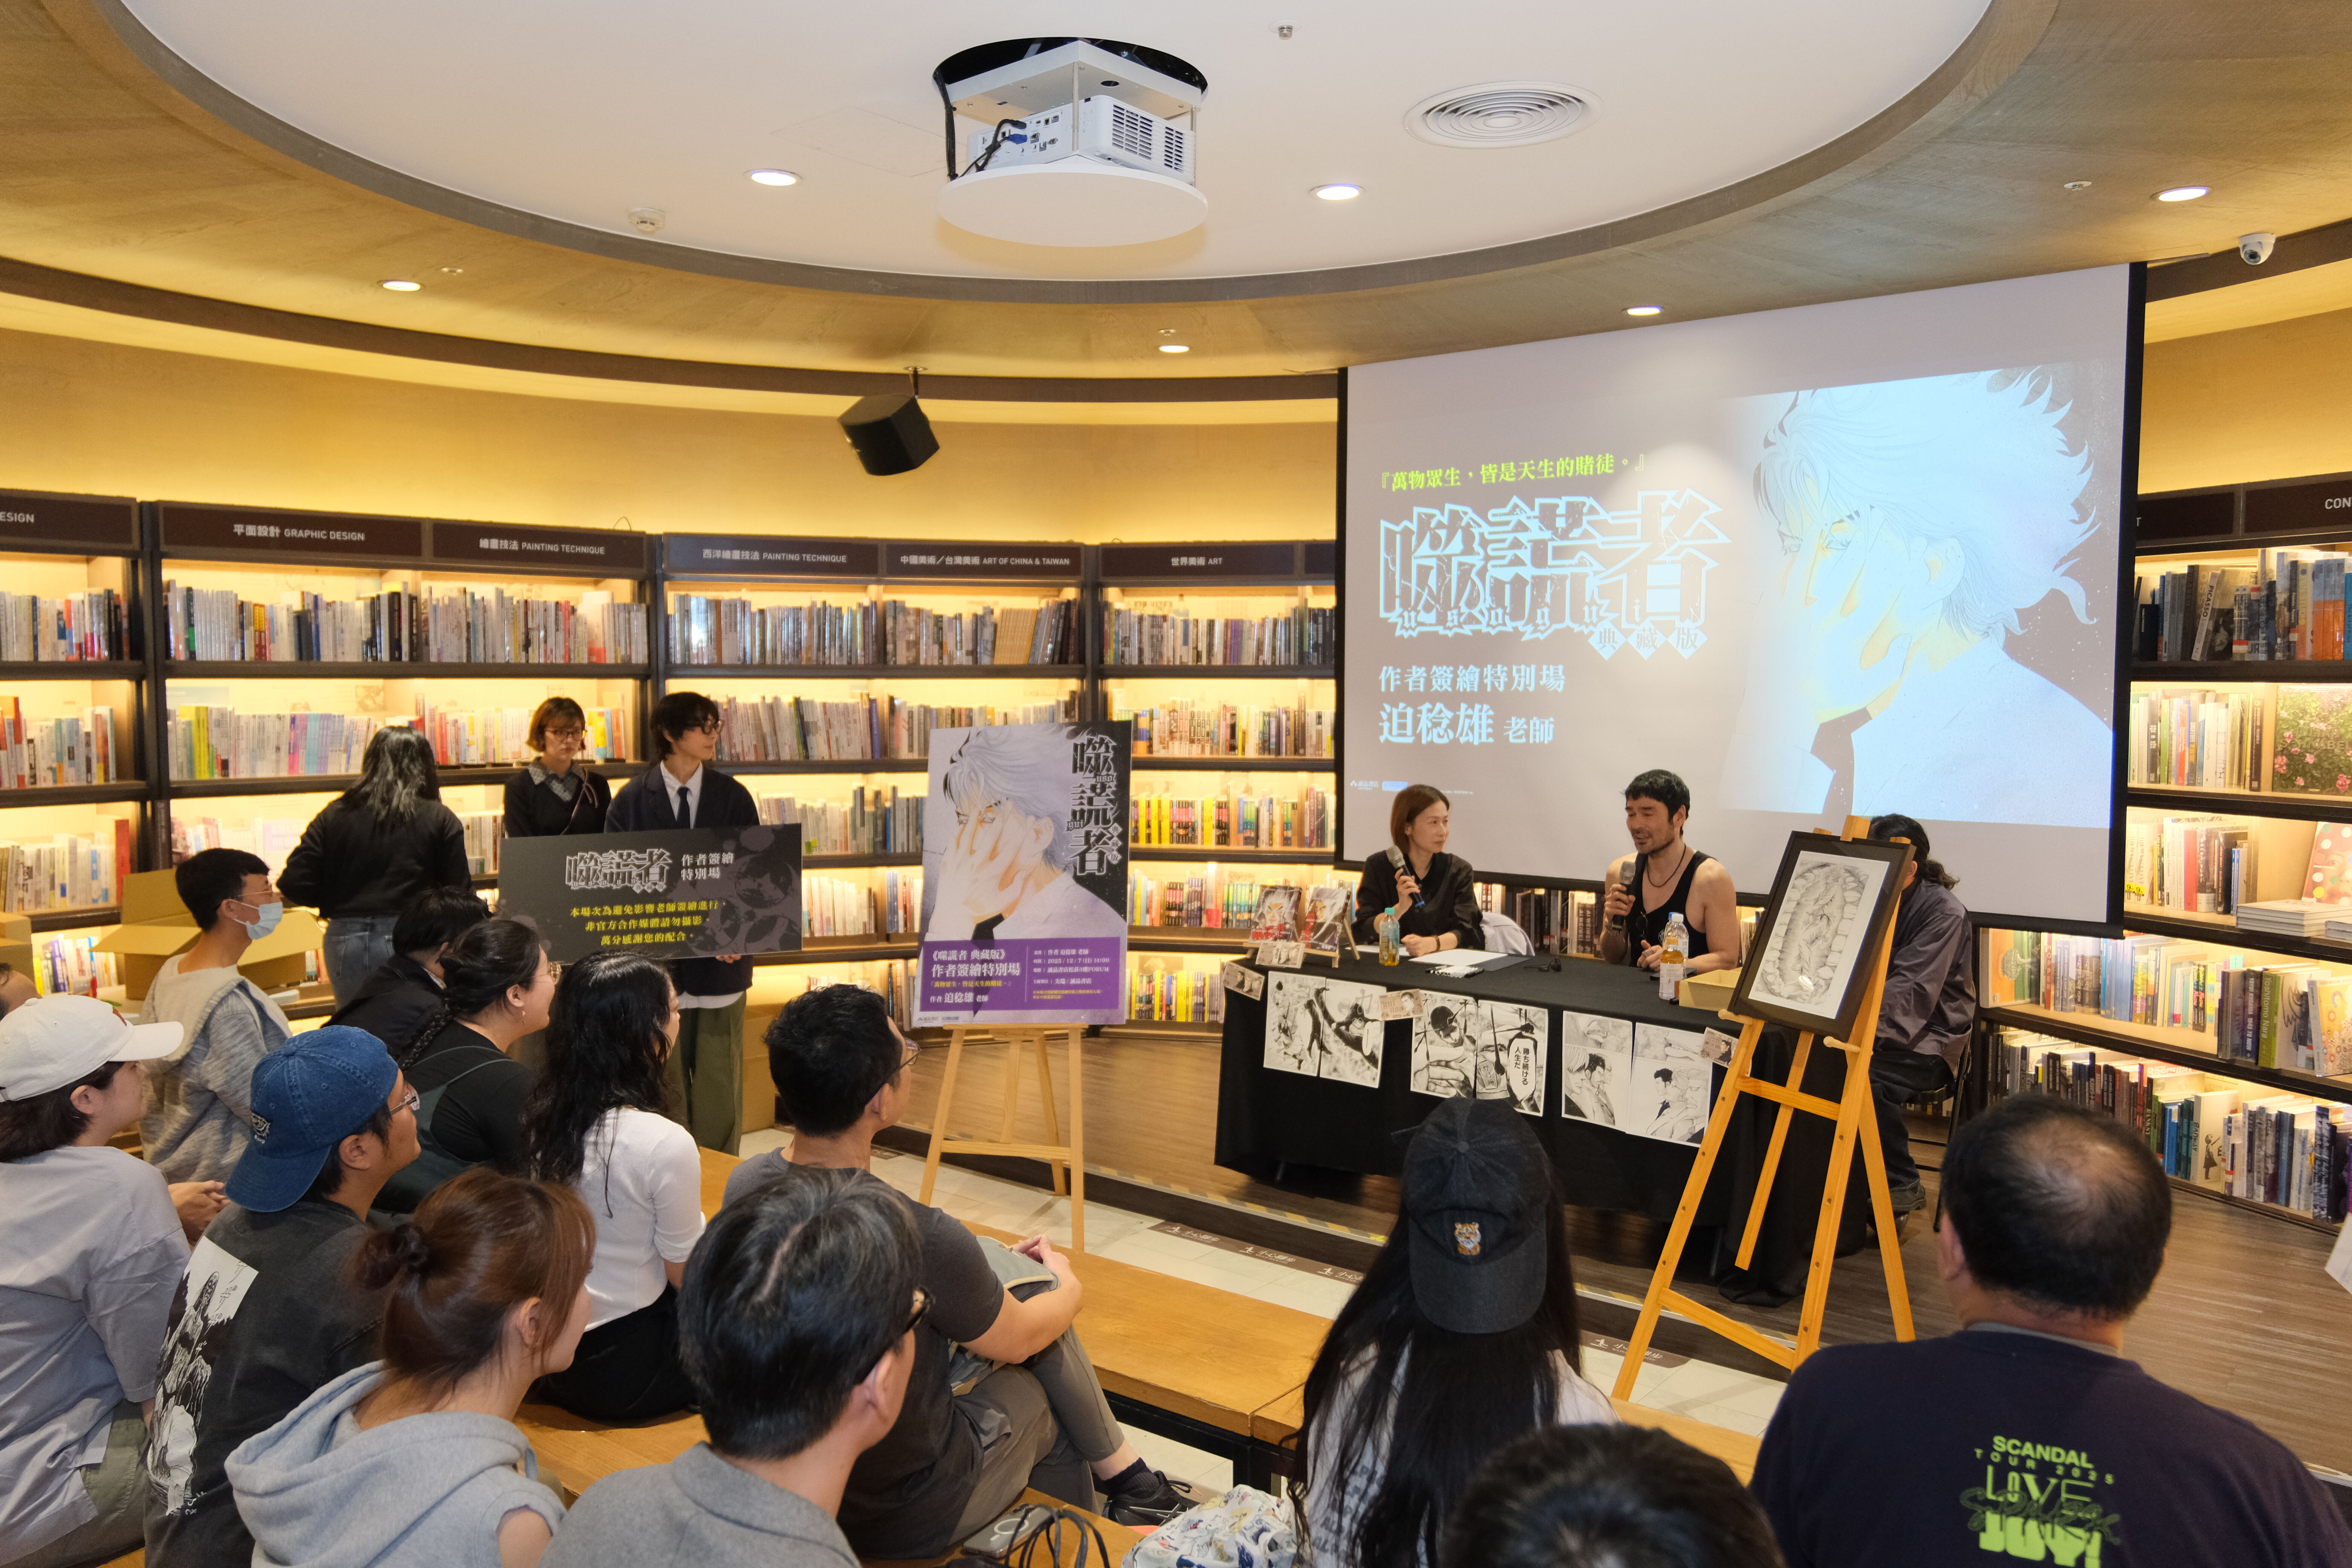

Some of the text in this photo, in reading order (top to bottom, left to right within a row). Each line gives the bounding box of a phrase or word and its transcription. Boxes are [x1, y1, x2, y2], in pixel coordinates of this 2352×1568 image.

[2325, 496, 2352, 510] CON
[233, 524, 365, 542] 平面設計 GRAPHIC DESIGN
[479, 538, 605, 555] 繪畫技法 PAINTING TECHNIQUE
[703, 549, 847, 563] 西洋繪畫技法 PAINTING TECHNIQUE
[1010, 557, 1033, 565] CHINA
[1042, 557, 1069, 566] TAIWAN
[1171, 557, 1205, 566] 世界美術
[2202, 585, 2214, 618] PICASSO
[1379, 664, 1565, 692] 作者簽繪特別場
[1379, 702, 1555, 744] 迫稔雄 老師
[1069, 734, 1117, 876] 噬謊者
[681, 853, 734, 866] 作者簽繪
[681, 867, 721, 880] 特別場
[585, 916, 709, 931] 非官方合作媒體請勿攝影。
[601, 931, 694, 946] 萬分感謝您的配合。
[932, 963, 1020, 977] 作者簽繪特別場
[944, 992, 974, 1003] 迫稔雄
[2261, 977, 2272, 1038] Yoshitomo Nara
[2248, 1029, 2252, 1037] TO
[1974, 1448, 2037, 1470] TOUR
[1992, 1435, 2094, 1468] SCANDAL
[1986, 1464, 2097, 1519] LOVE
